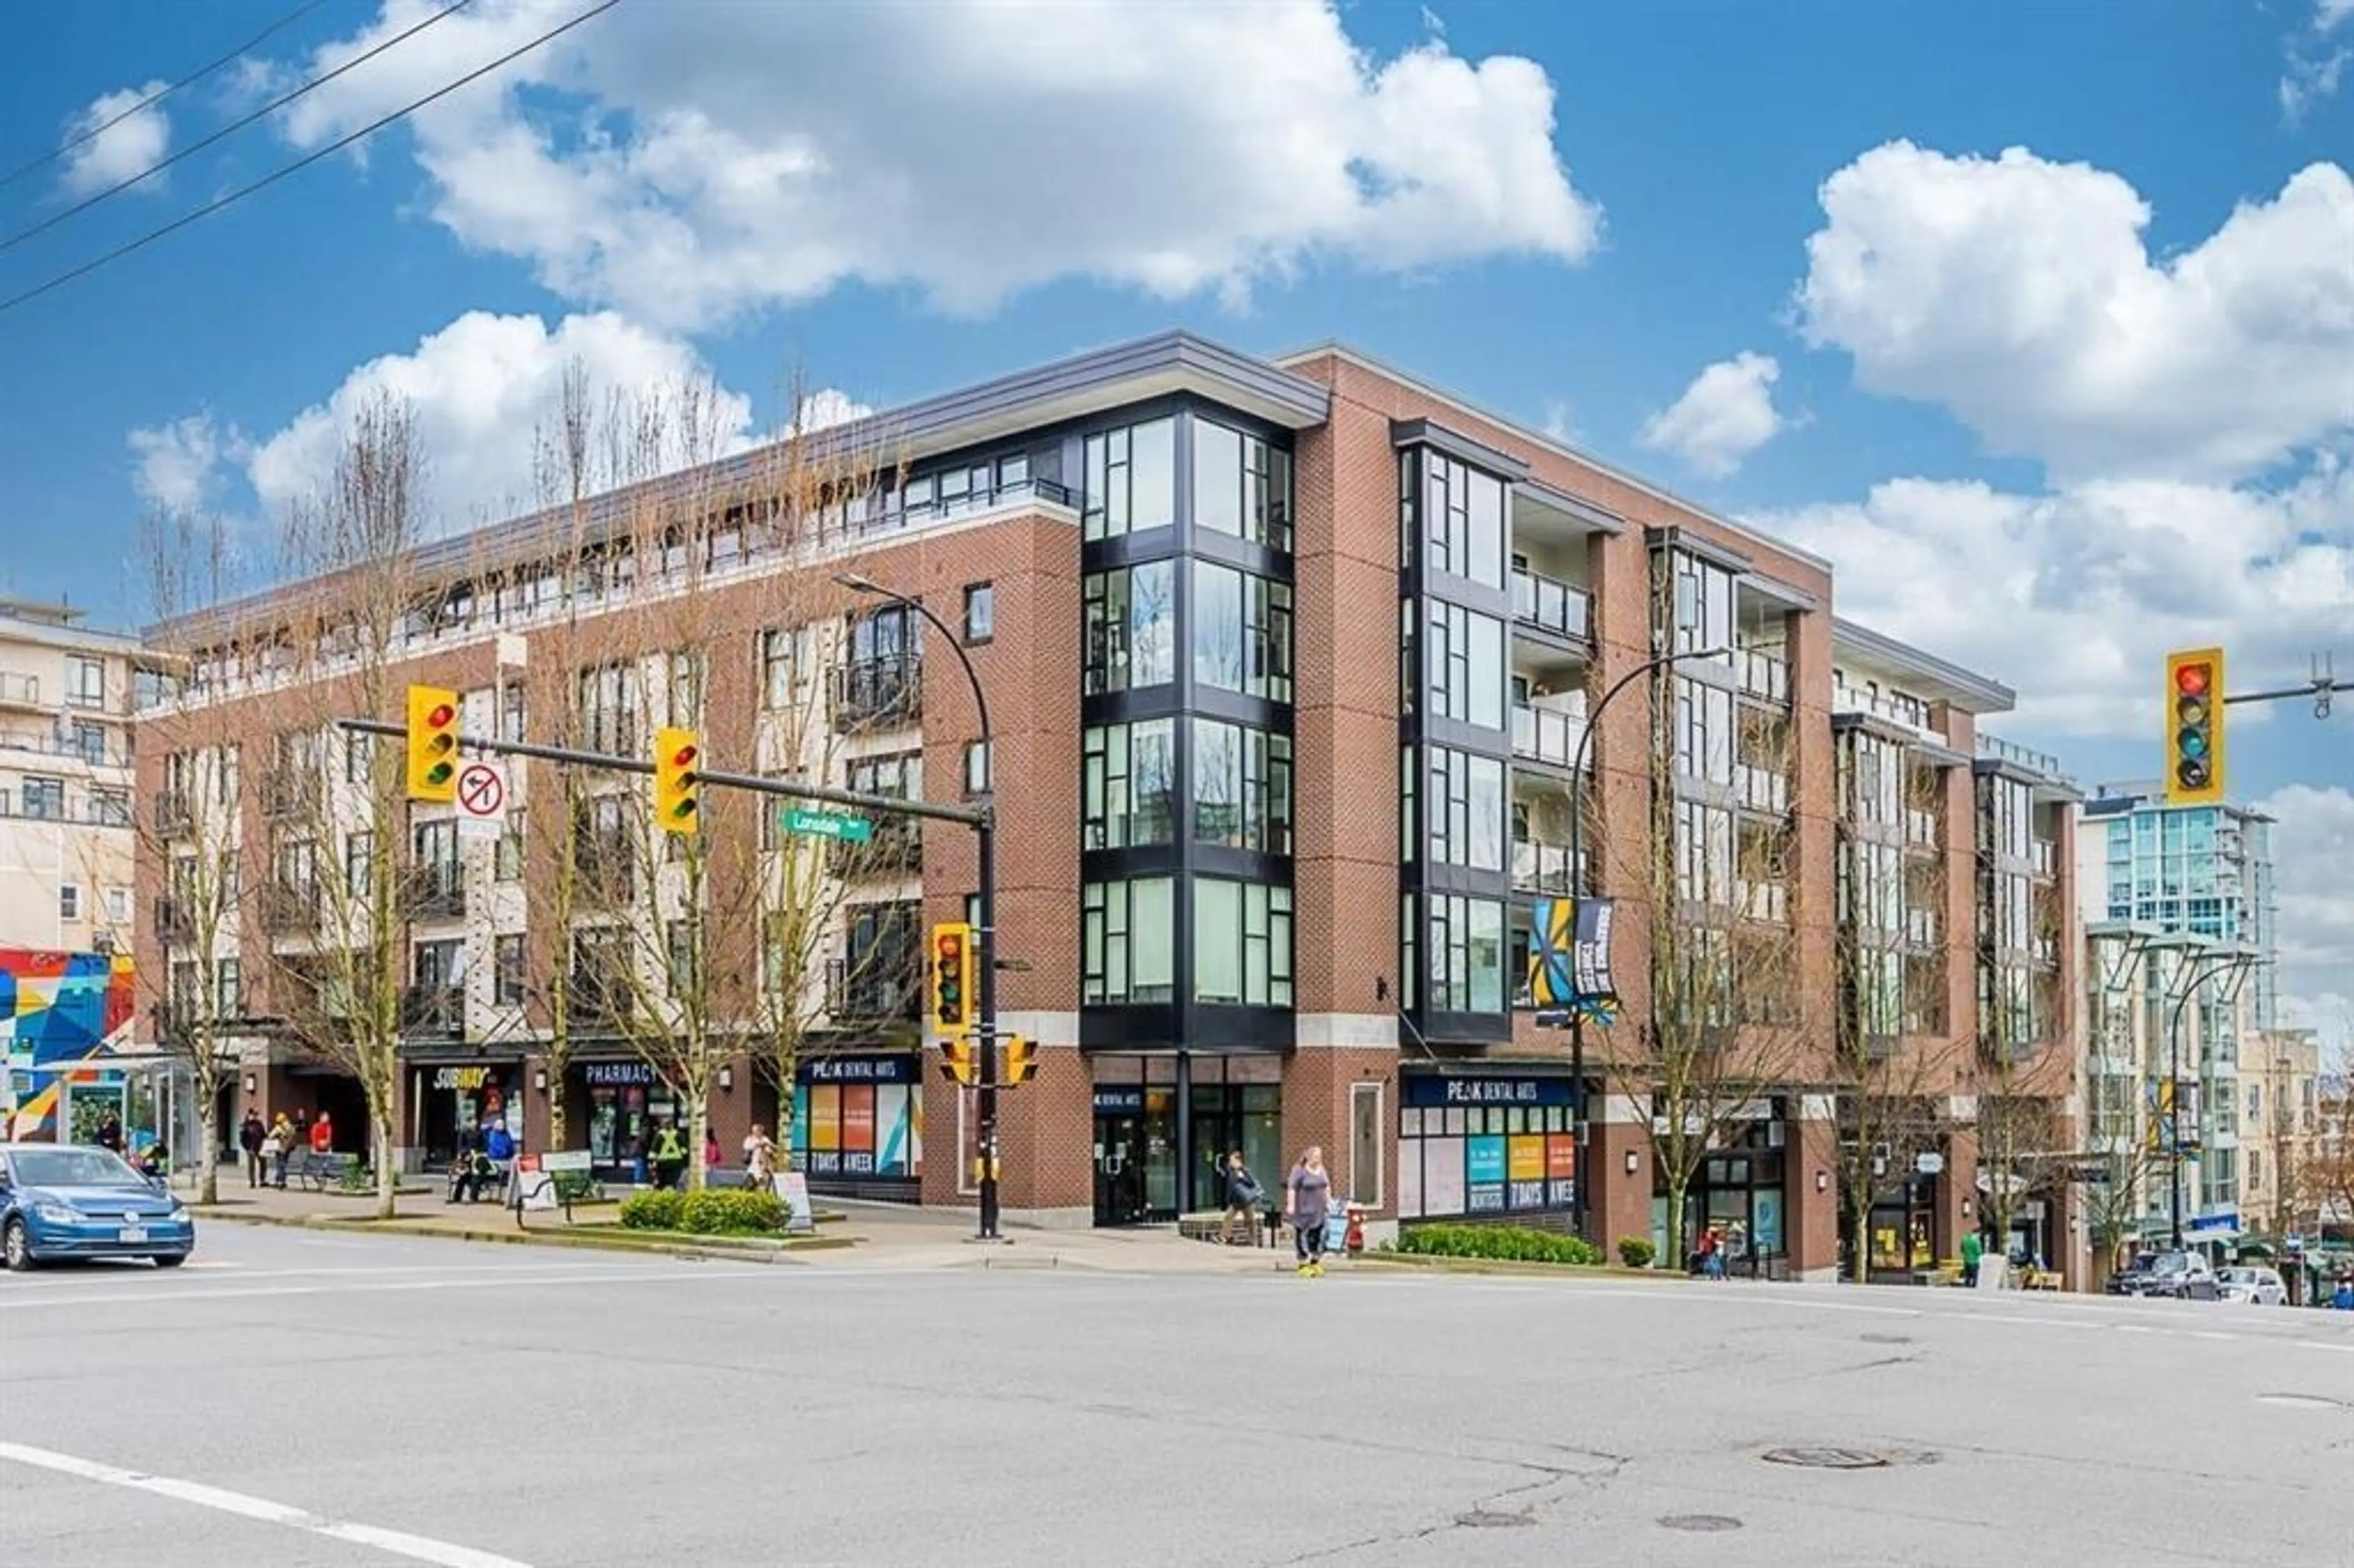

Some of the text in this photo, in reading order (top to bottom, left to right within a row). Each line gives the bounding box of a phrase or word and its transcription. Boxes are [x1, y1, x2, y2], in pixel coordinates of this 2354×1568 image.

[433, 1067, 490, 1089] SUBWAY
[845, 1061, 873, 1077] DENTAL
[876, 1060, 895, 1077] ARTS
[1484, 1081, 1514, 1100] DENTAL
[1517, 1082, 1536, 1100] ARTS
[818, 1153, 839, 1172] DAYS
[850, 1154, 872, 1170] WEEK
[1519, 1182, 1544, 1206] DAYS
[1557, 1178, 1574, 1202] WEE
